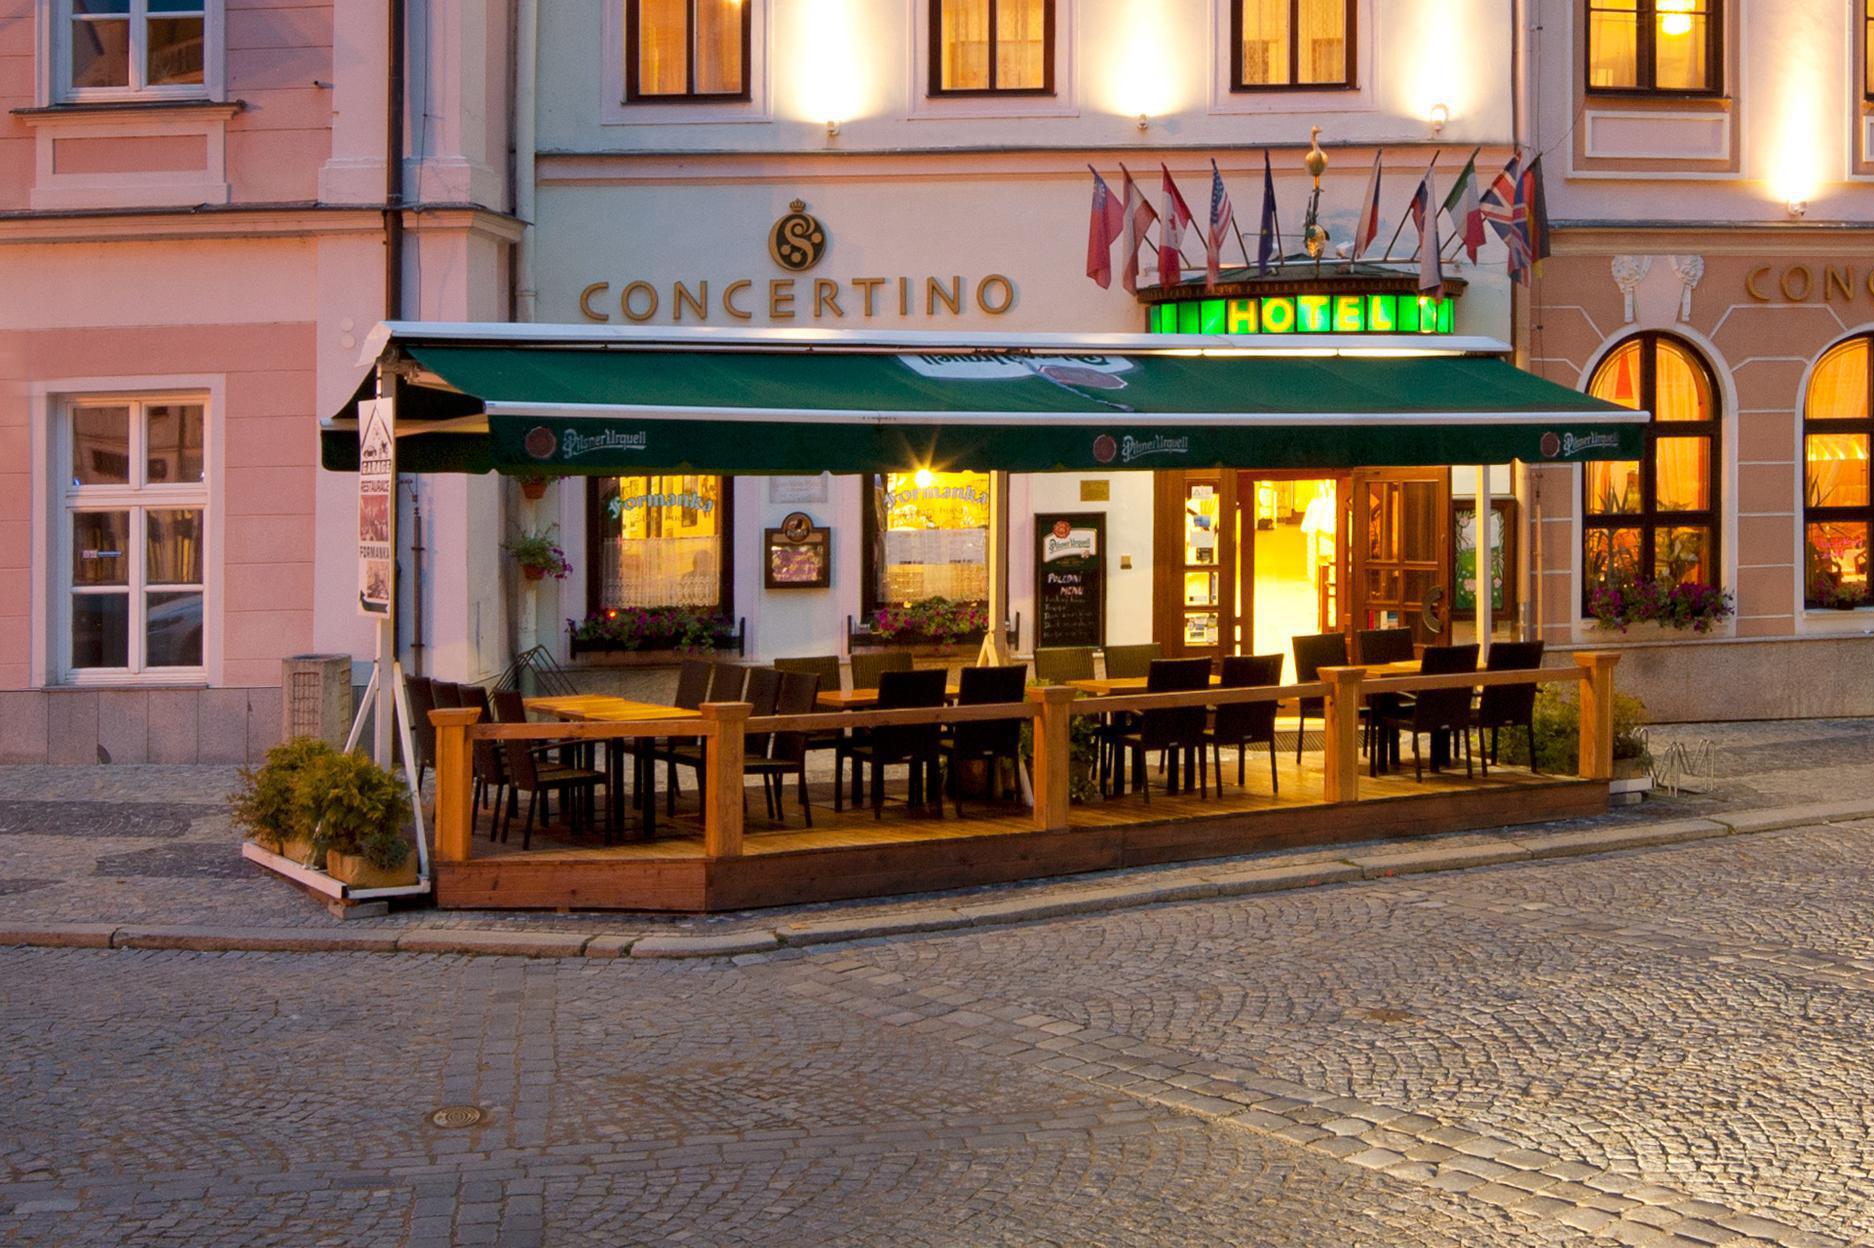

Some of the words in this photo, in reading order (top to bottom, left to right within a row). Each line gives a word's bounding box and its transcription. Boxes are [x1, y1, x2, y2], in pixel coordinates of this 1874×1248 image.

[579, 273, 1015, 322] CONCERTINO
[1228, 295, 1393, 332] HOTEL
[562, 428, 606, 459] Pilsner
[604, 428, 647, 450] Urquell
[1154, 434, 1188, 453] Urquell
[606, 491, 714, 520] Formanka
[883, 484, 989, 510] Formanka
